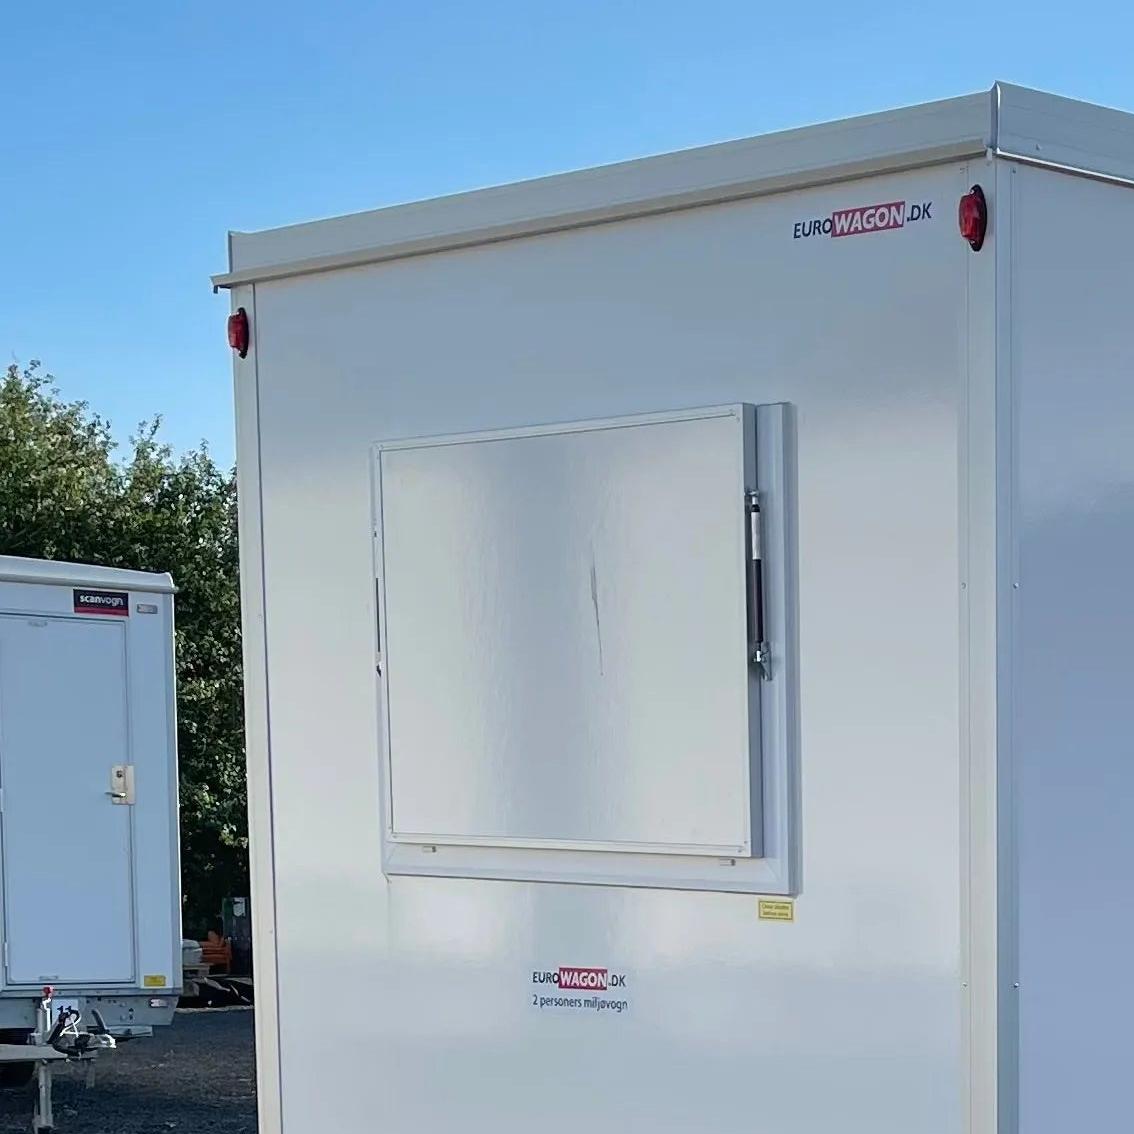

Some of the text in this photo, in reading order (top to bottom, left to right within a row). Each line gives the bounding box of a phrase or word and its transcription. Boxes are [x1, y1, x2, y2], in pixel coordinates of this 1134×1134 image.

[794, 202, 932, 238] EUROWAGON.DK
[80, 594, 123, 606] scanvogn
[532, 970, 626, 988] EUROWAGON.DK
[532, 994, 538, 1006] 2
[540, 996, 582, 1009] personers
